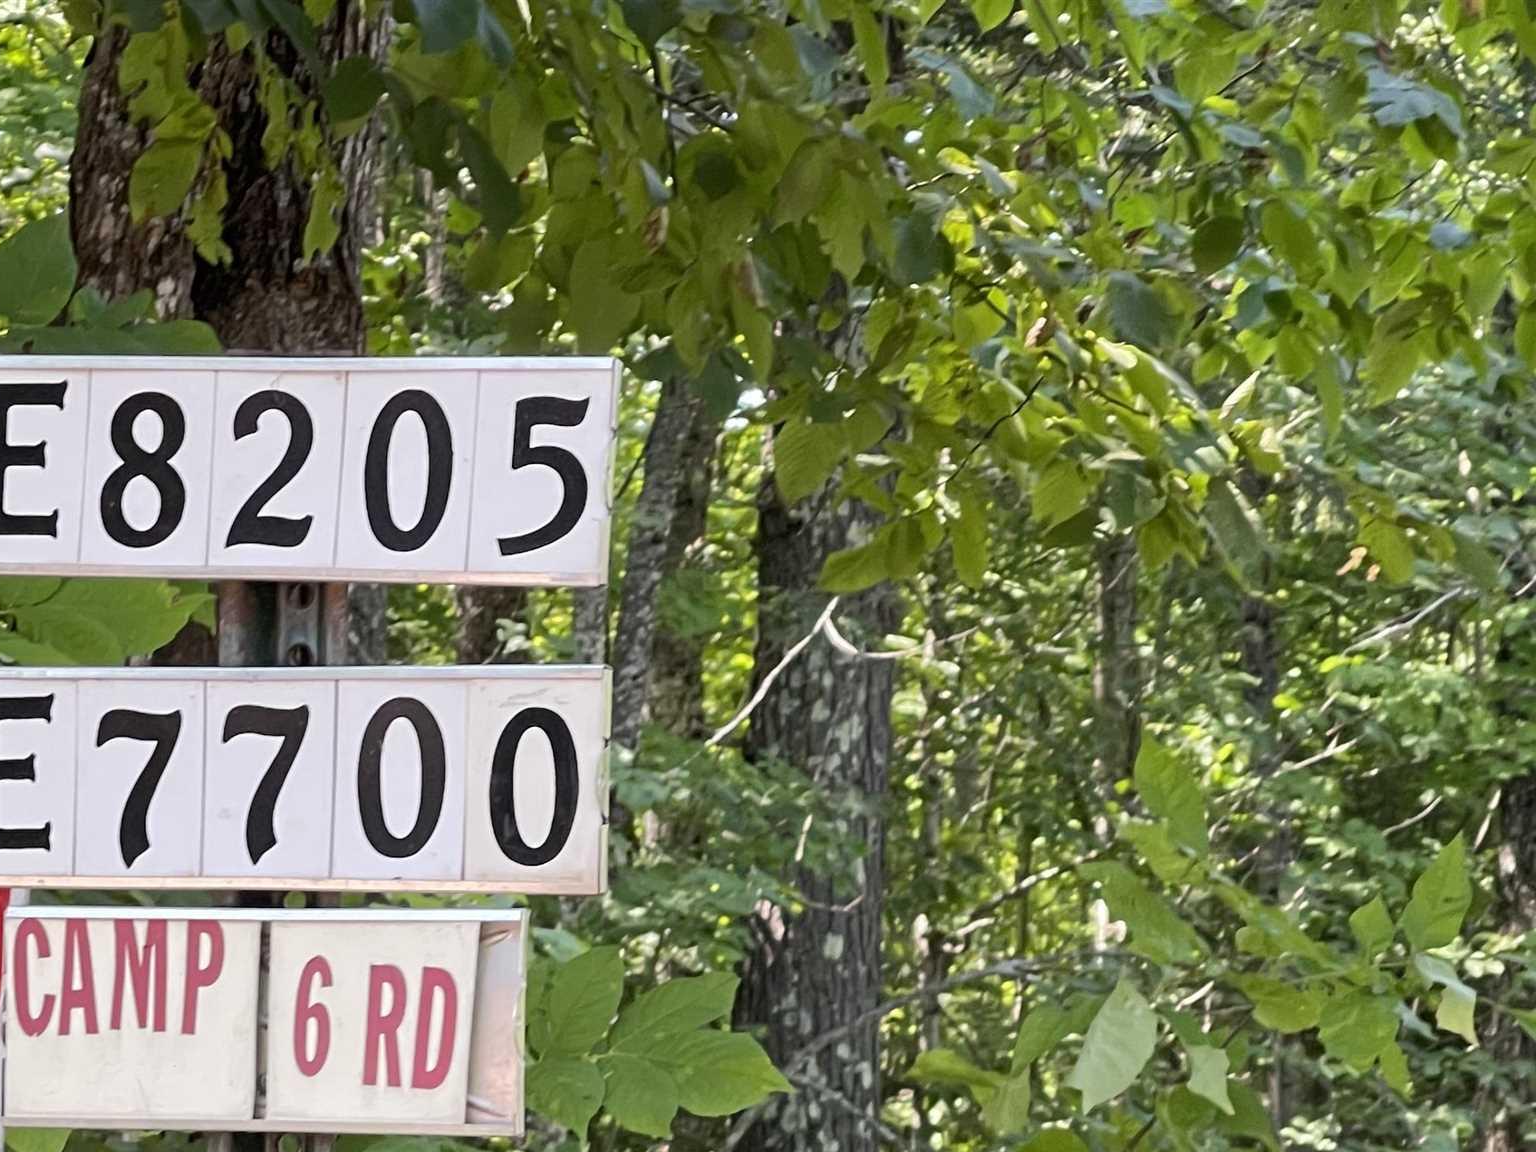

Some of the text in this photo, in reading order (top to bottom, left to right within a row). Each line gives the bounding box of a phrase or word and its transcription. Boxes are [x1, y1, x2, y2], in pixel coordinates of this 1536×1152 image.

[13, 917, 459, 1089] CAMP 6 RD
